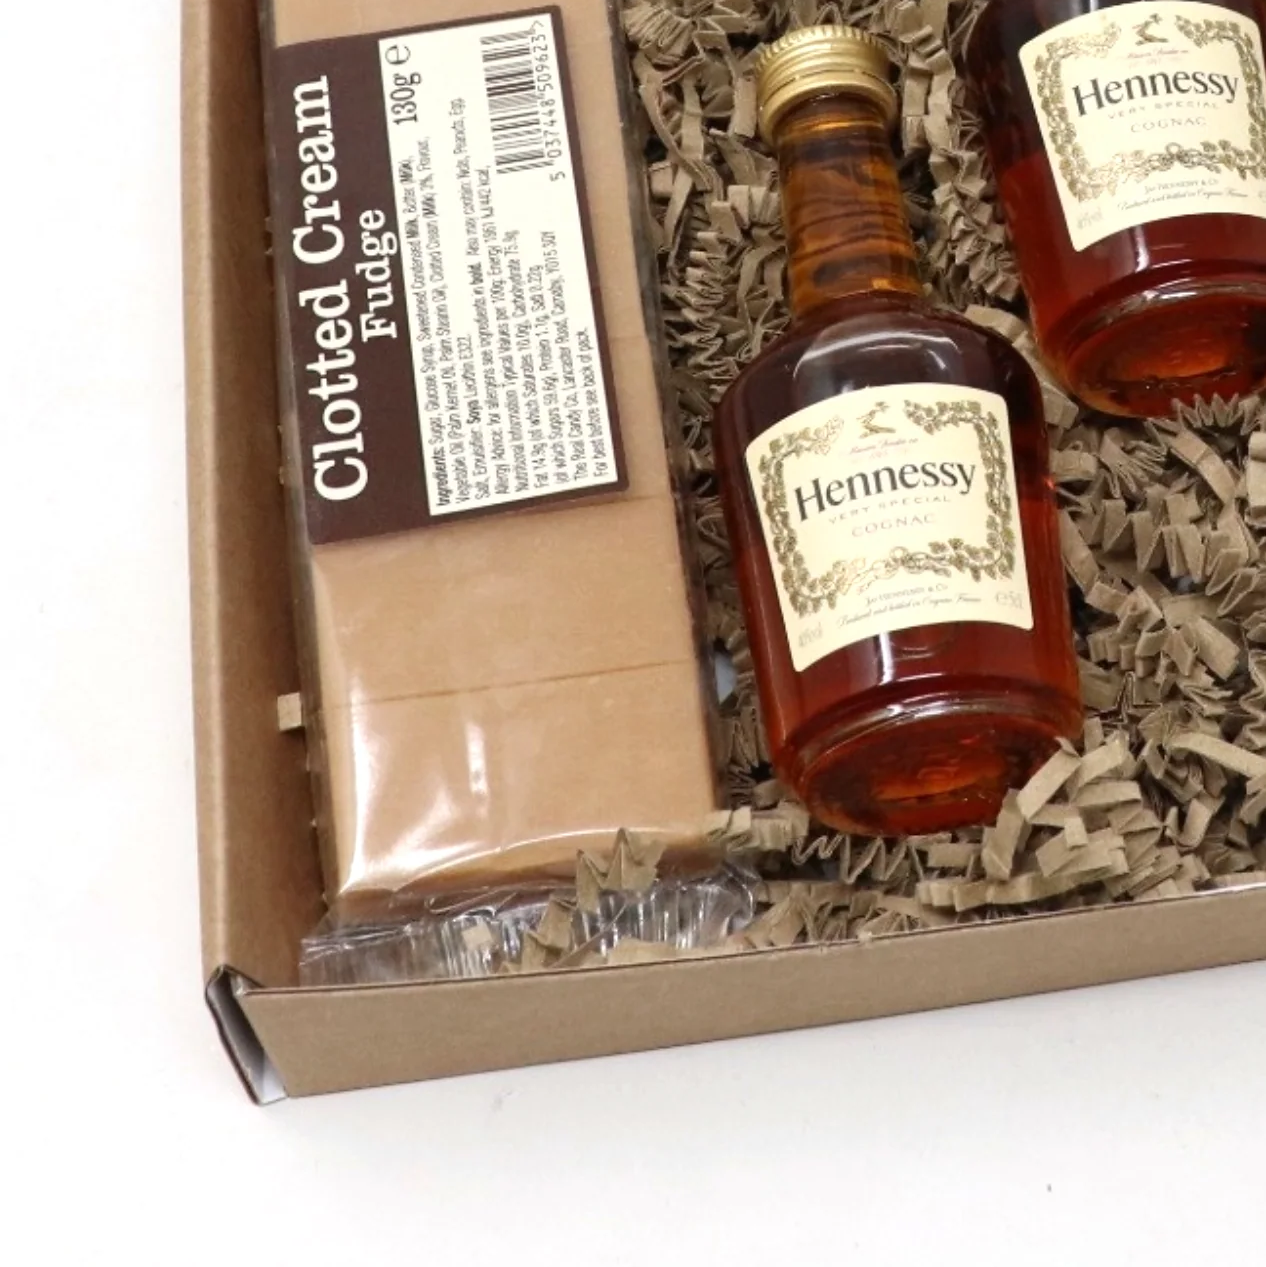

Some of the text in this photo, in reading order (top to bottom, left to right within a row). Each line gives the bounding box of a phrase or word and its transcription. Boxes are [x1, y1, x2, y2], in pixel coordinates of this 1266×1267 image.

[389, 71, 422, 125] 130g
[530, 33, 566, 182] 5 037448 509623
[1072, 70, 1239, 117] Hennessy
[1107, 100, 1220, 120] VERY SPECIAL
[1130, 116, 1208, 134] COGNAC
[292, 77, 367, 499] Clotted Cream
[355, 209, 397, 340] Fudge
[465, 398, 483, 425] Soya
[794, 461, 977, 523] Hennessy
[828, 495, 952, 525] VERY SPECIAL
[851, 513, 937, 538] COGNAC
